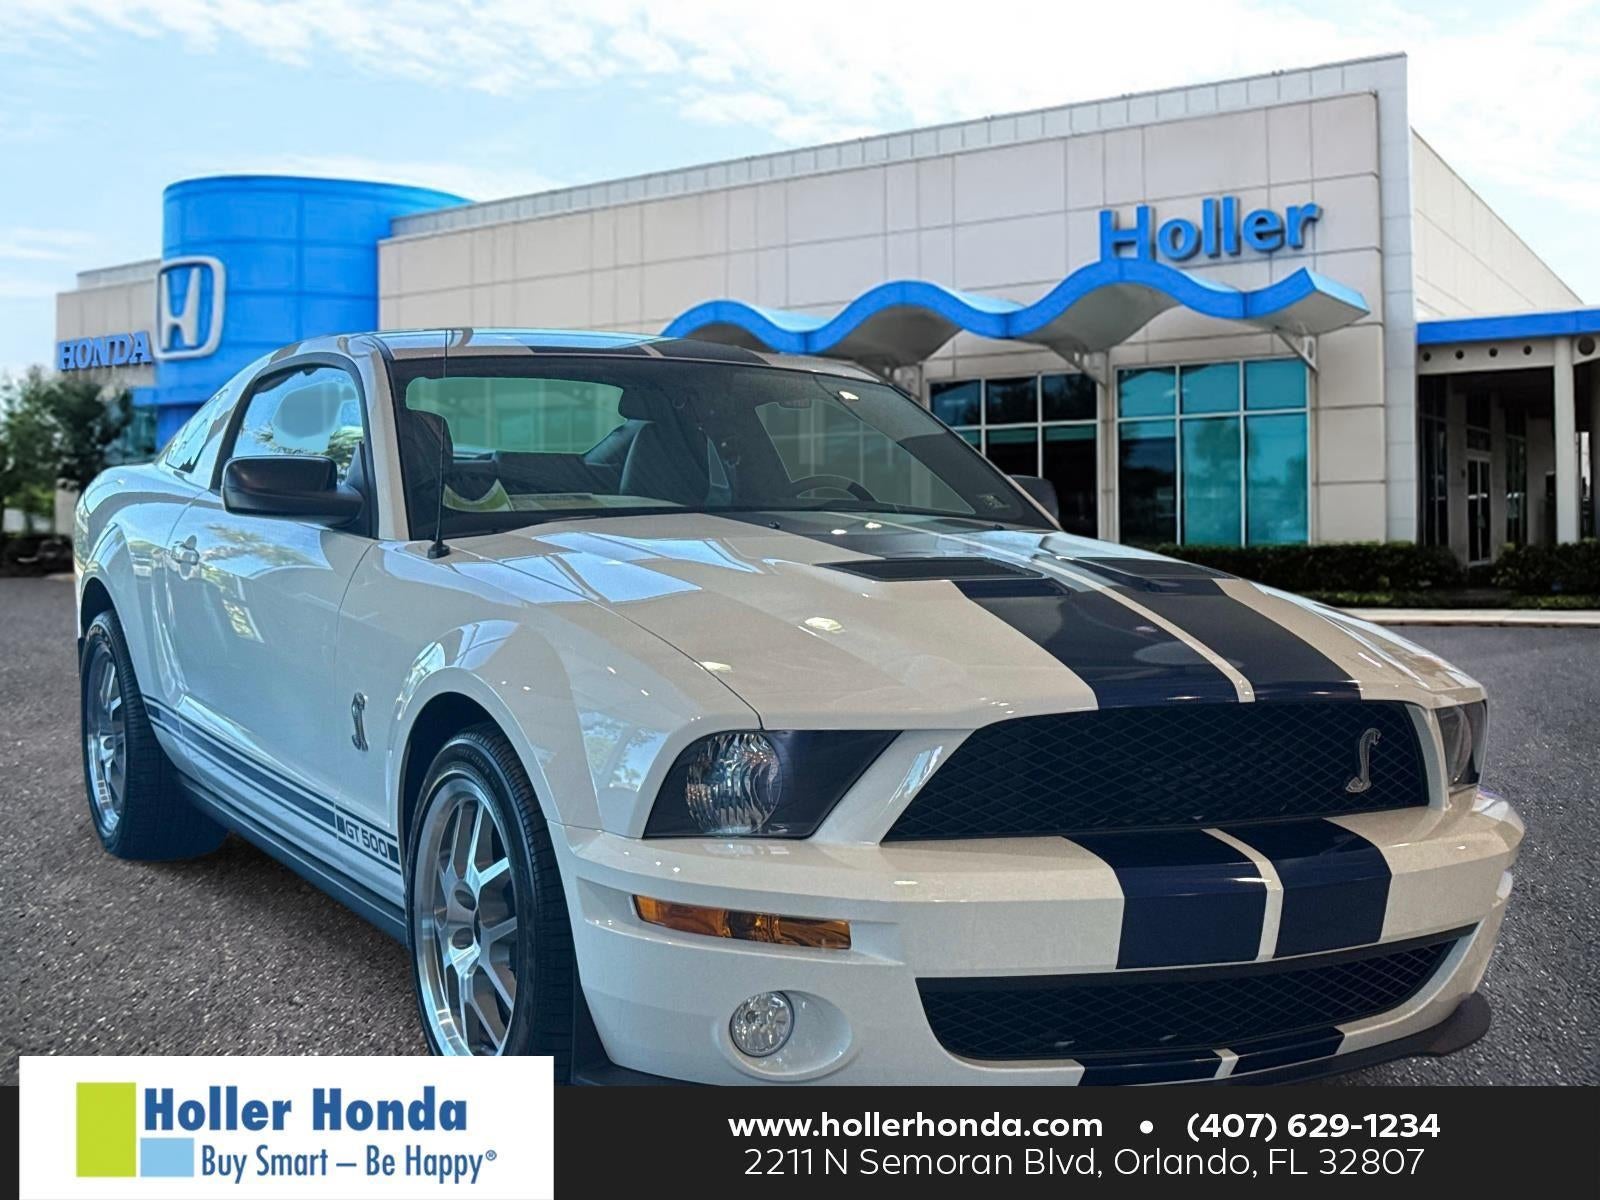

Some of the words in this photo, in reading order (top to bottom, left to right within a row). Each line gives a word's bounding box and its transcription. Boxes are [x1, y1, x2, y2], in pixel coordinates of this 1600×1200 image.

[1099, 196, 1321, 261] Holler
[58, 331, 153, 372] HONDA
[346, 820, 360, 843] GT
[361, 828, 388, 859] 500
